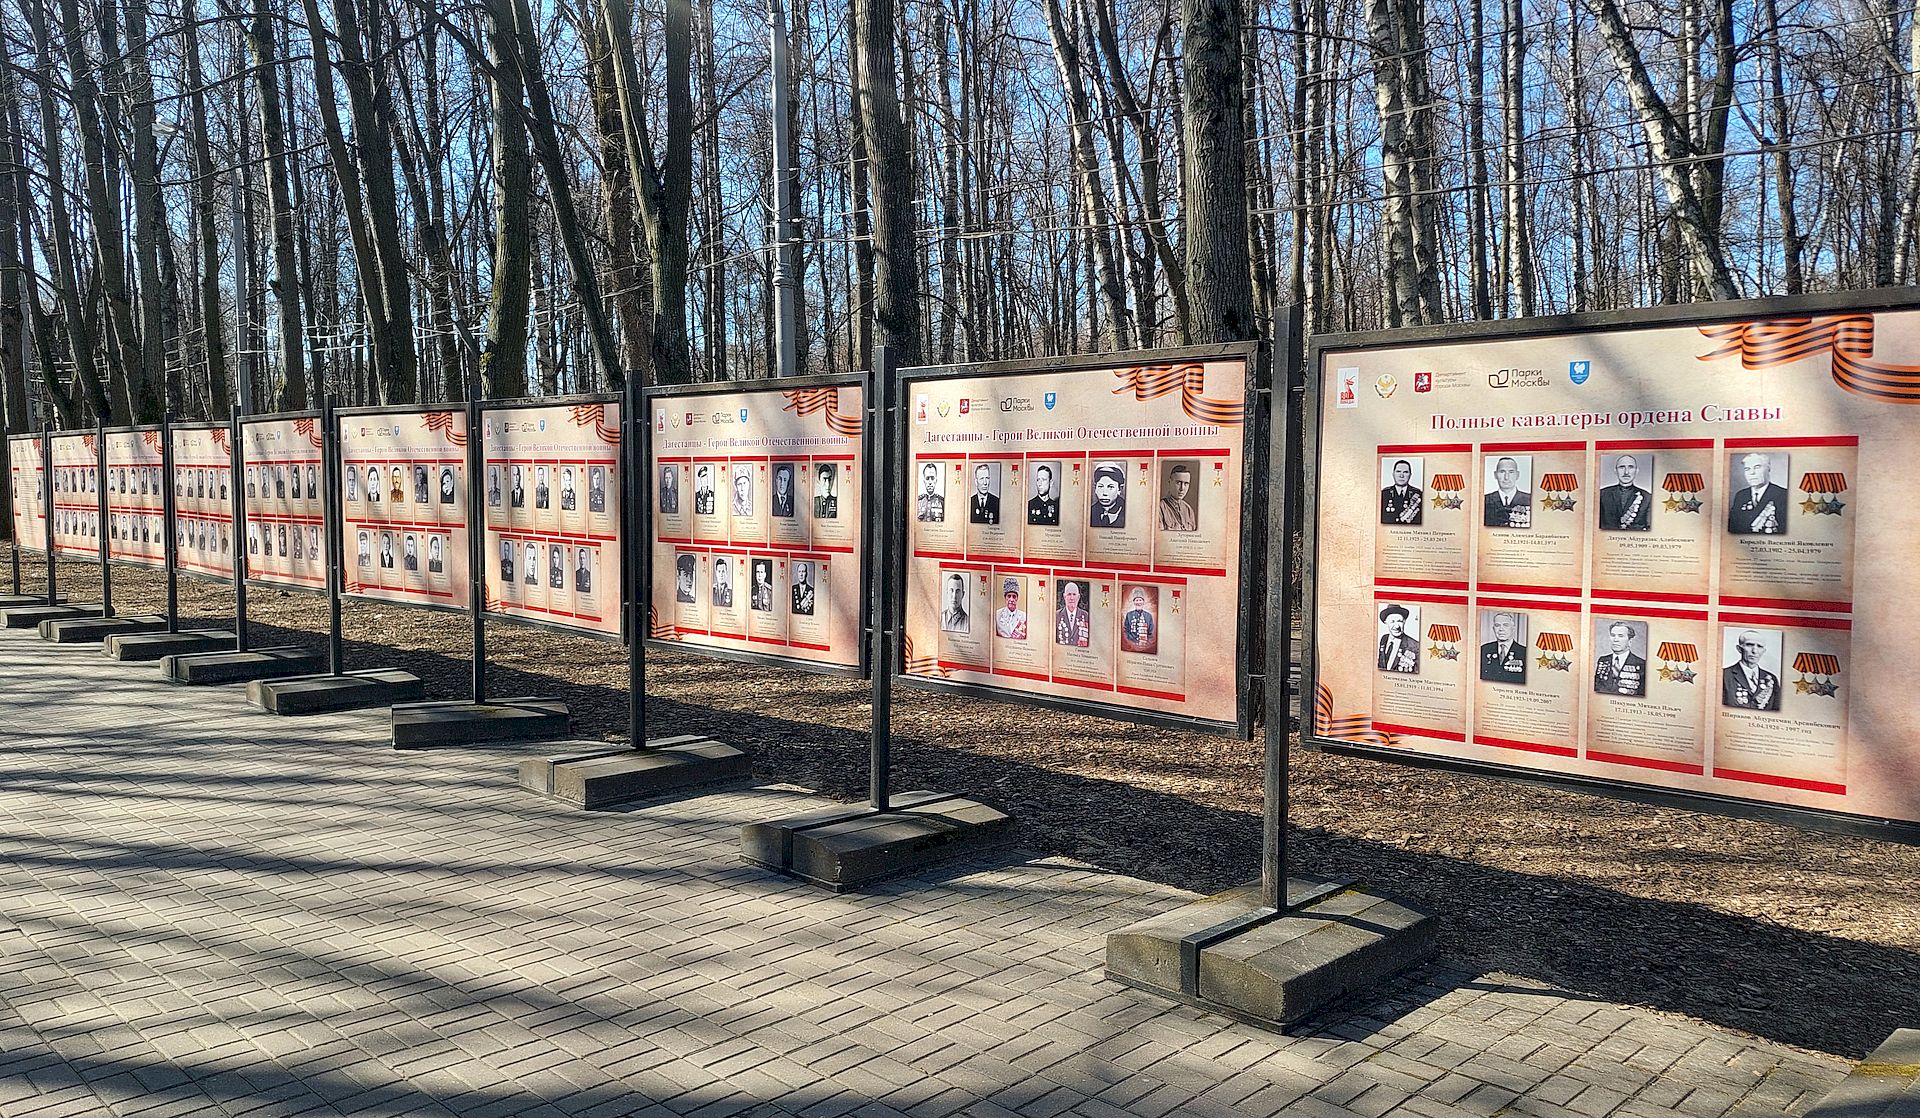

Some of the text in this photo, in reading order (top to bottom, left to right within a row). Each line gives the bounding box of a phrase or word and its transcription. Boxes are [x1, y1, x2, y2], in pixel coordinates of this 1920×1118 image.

[1511, 368, 1542, 380] Парки
[1511, 377, 1550, 388] Москвы
[1013, 398, 1031, 407] Парки
[1013, 403, 1035, 412] Москвы
[1431, 404, 1783, 430] Полные кавалеры ордена Славы
[924, 431, 983, 443] Дагестанцы
[993, 430, 1023, 443] Герои
[1026, 427, 1073, 440] Великой
[1077, 424, 1170, 439] Отечественной
[1174, 424, 1219, 437] войны
[663, 439, 702, 449] Дагестанцы
[708, 438, 728, 449] Герои
[730, 437, 760, 447] Великой
[762, 436, 819, 447] Отечественной
[821, 435, 848, 445] войны
